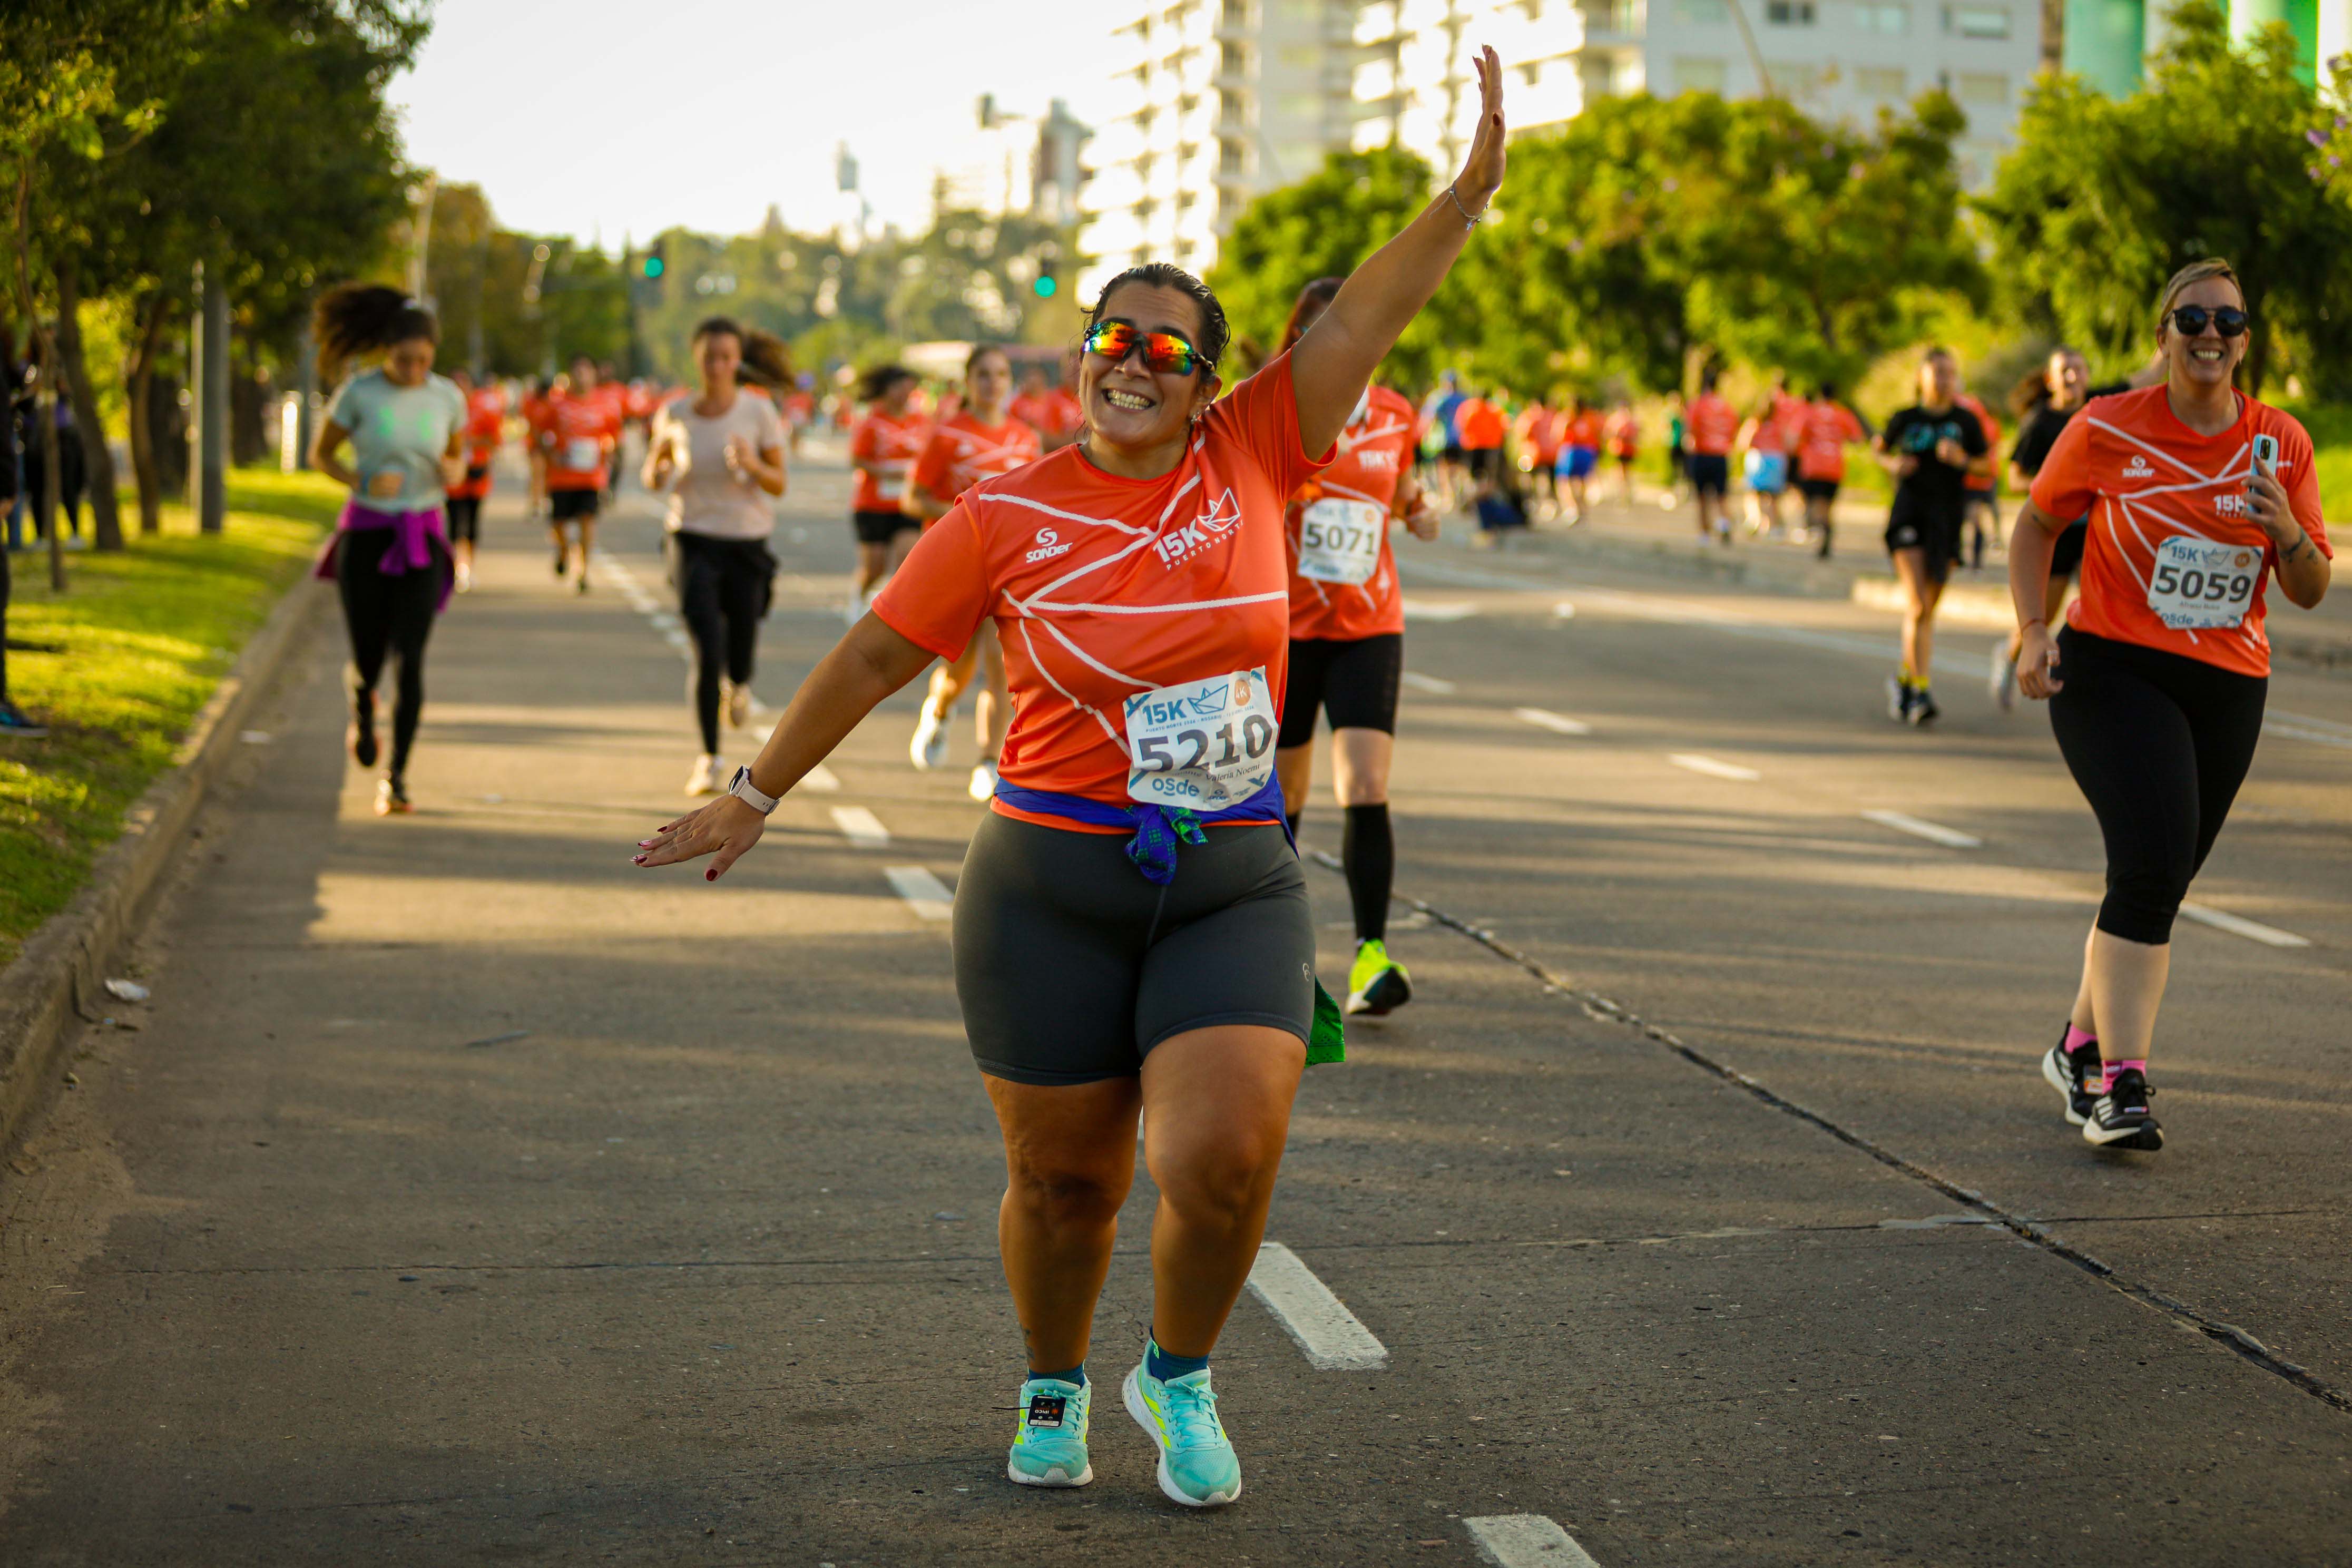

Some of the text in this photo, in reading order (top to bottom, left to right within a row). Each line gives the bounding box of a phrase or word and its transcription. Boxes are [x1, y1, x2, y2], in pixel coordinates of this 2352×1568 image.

[1153, 518, 1208, 562] 15K
[1305, 522, 1376, 555] 5071
[1167, 542, 1211, 571] PUERTO
[2171, 545, 2198, 563] 15K
[2155, 564, 2251, 602] 5059
[2161, 612, 2194, 625] osde
[1142, 698, 1188, 726] 15K
[1138, 714, 1273, 772] 5210
[1206, 770, 1233, 781] Valeria
[1237, 761, 1260, 778] Noemi
[1152, 778, 1200, 797] osde
